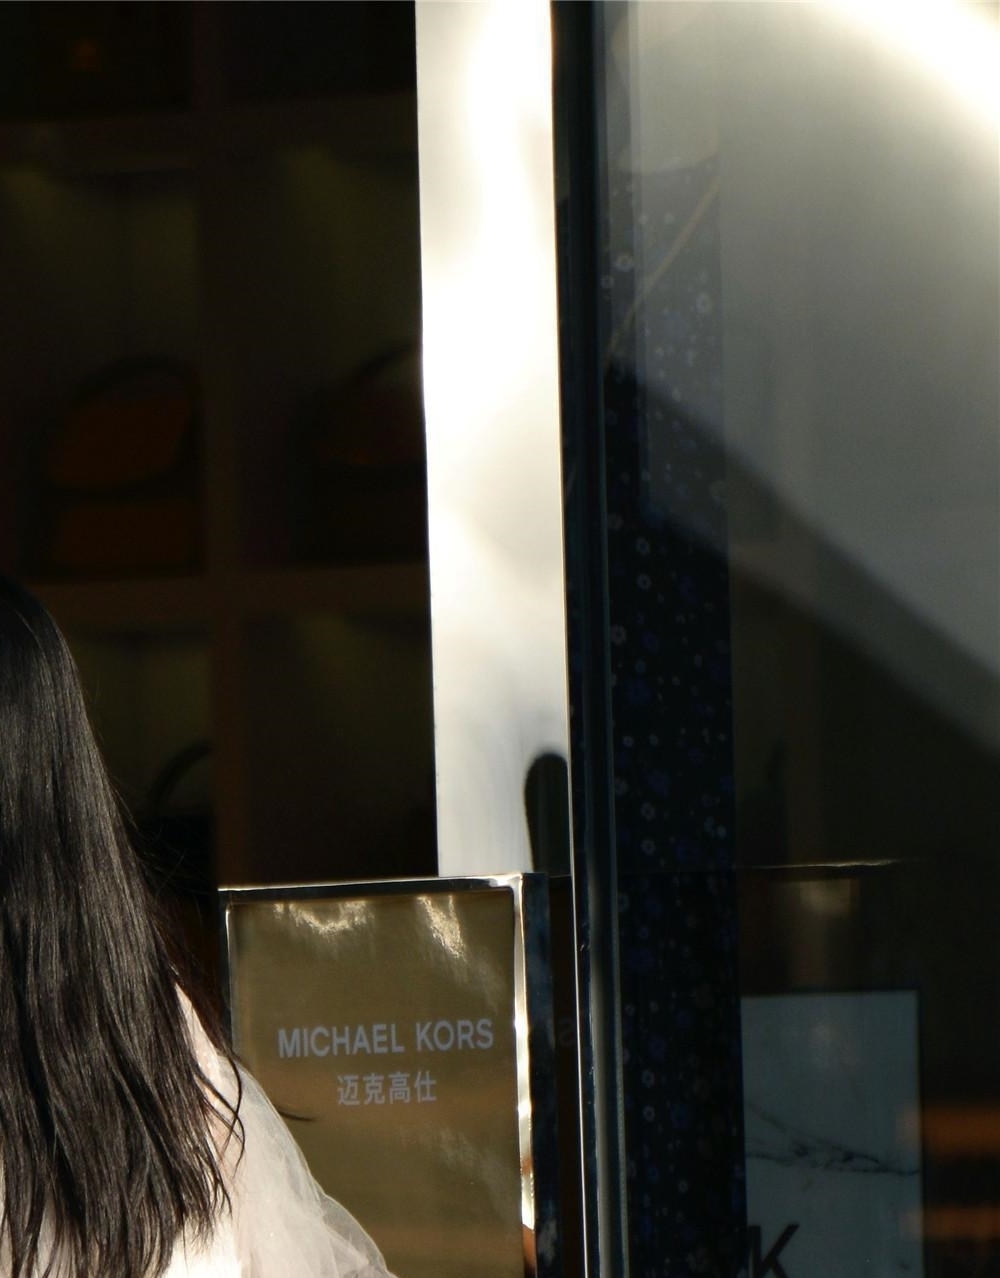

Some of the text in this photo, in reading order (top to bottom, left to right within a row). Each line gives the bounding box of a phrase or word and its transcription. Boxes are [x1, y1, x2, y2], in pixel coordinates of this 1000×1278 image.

[278, 1018, 494, 1058] MICHAEL KORS
[336, 1070, 438, 1106] 迈克高仕
